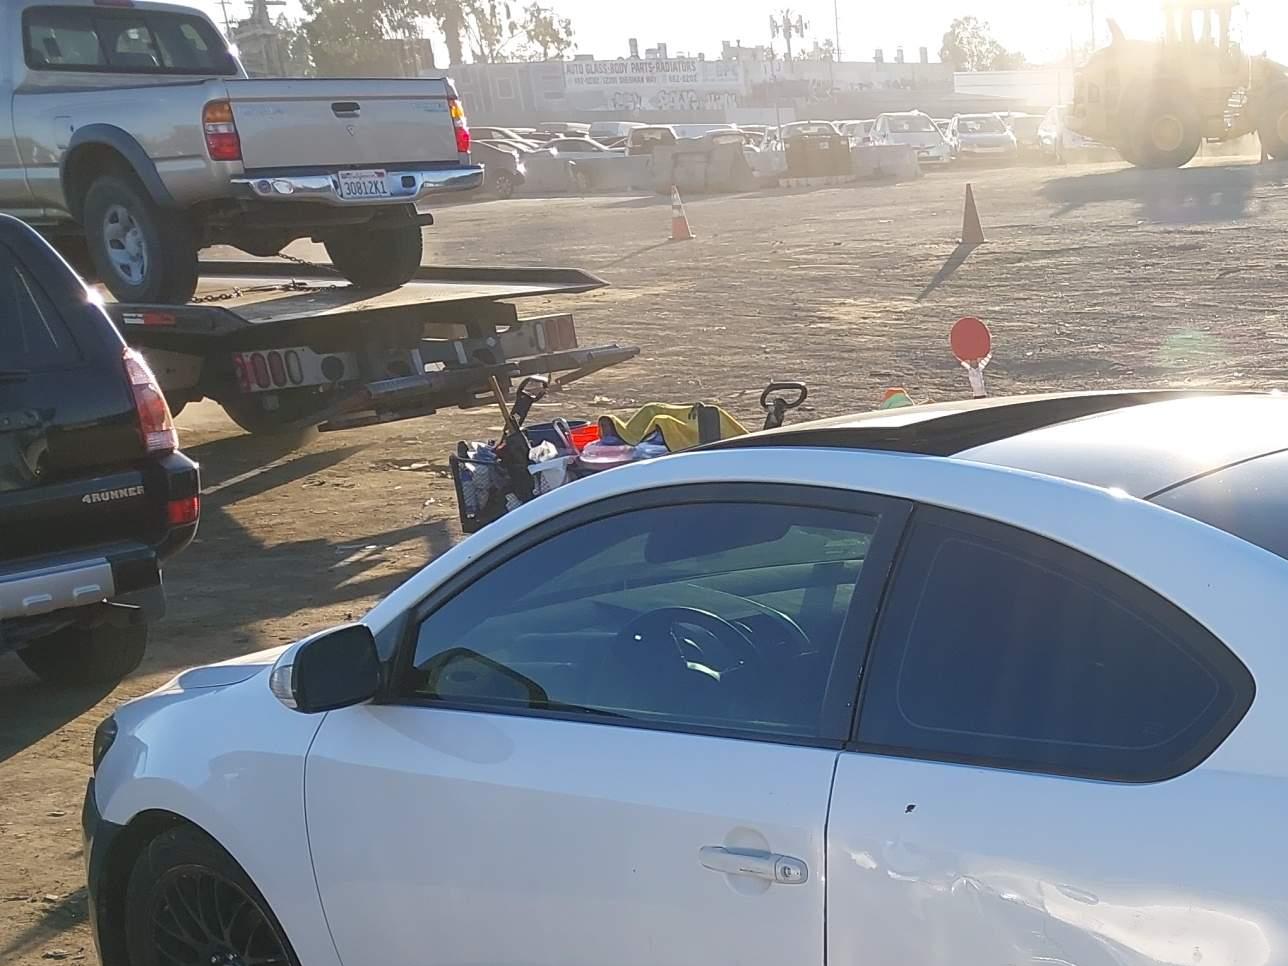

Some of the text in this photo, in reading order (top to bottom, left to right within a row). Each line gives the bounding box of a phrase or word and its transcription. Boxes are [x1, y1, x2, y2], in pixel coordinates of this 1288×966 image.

[566, 63, 584, 74] AUTO
[344, 180, 388, 195] 30812K1
[81, 485, 145, 504] 4RUNNER
